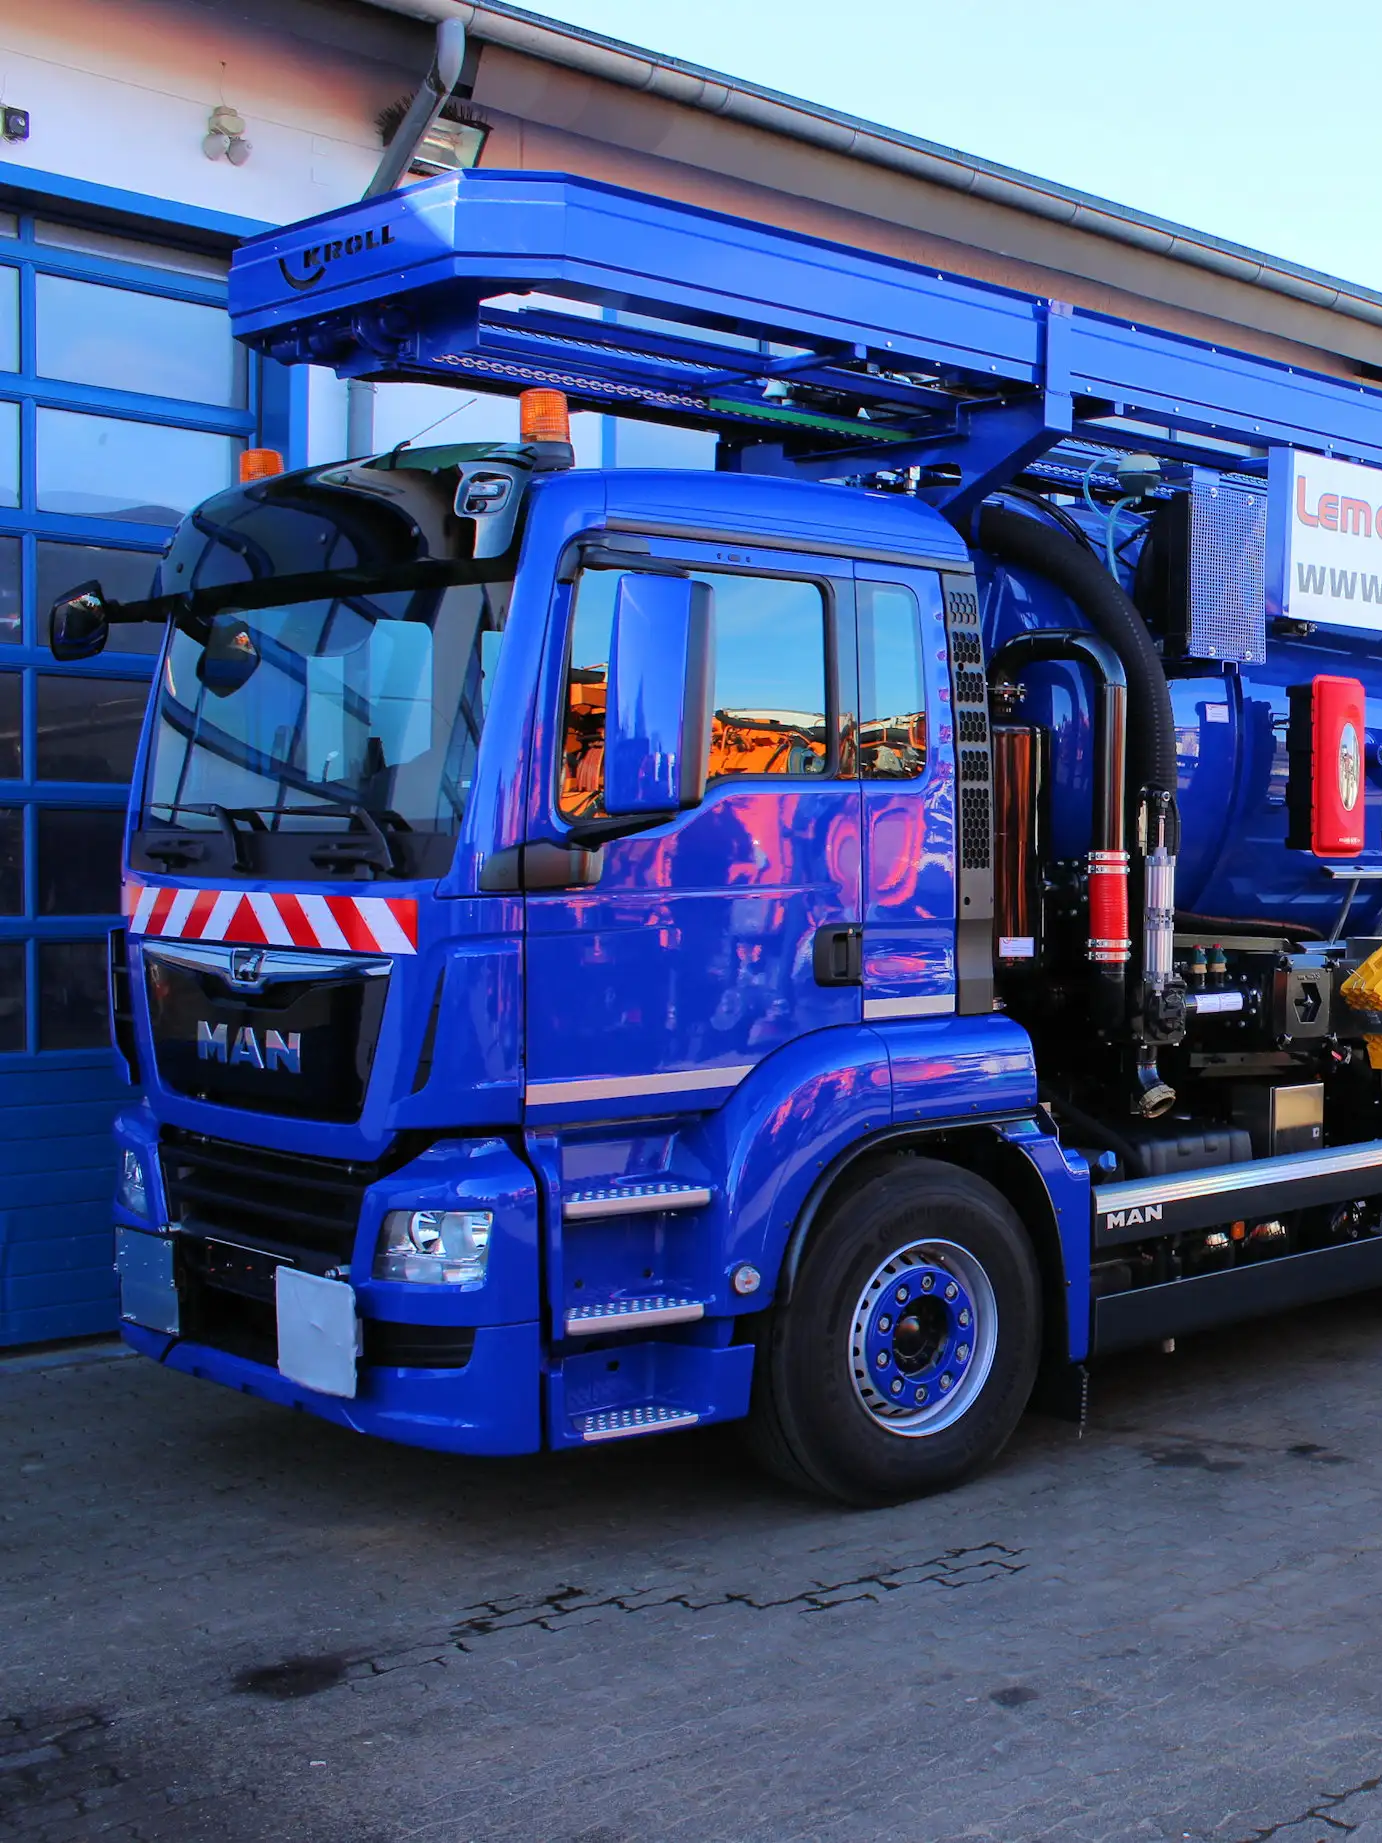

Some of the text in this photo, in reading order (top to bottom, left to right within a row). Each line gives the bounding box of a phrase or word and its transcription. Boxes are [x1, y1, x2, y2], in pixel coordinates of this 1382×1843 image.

[303, 224, 396, 269] KROLL
[197, 1020, 302, 1074] MAN
[1106, 1203, 1163, 1230] MAN
